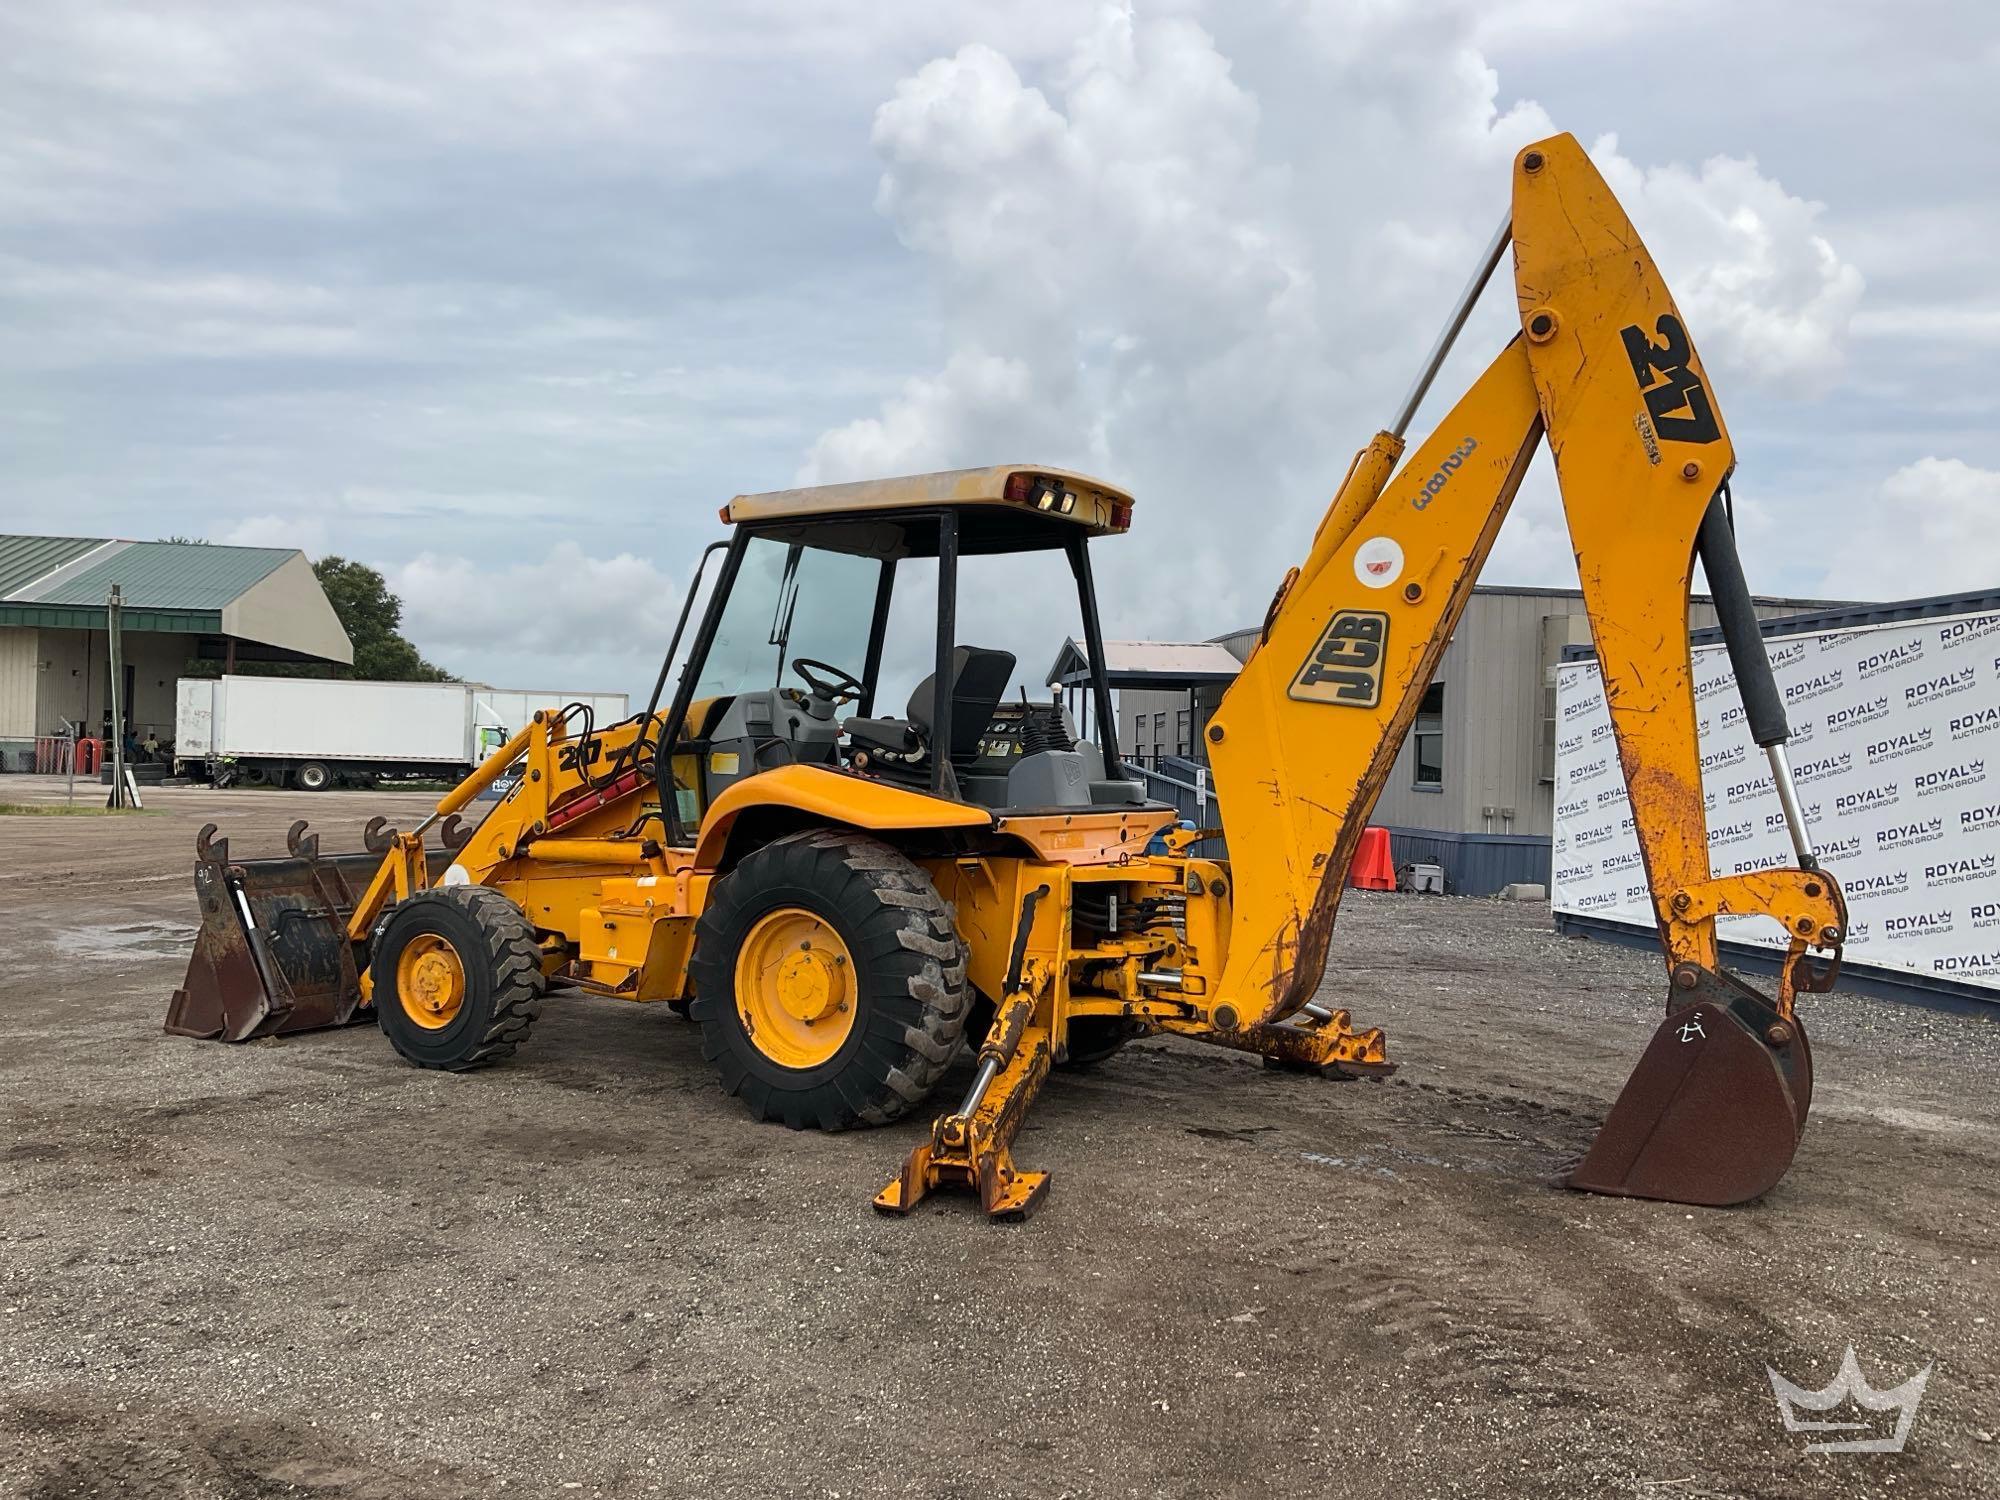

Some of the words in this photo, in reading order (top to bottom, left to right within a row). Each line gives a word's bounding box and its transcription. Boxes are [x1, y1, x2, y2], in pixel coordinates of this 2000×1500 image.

[1620, 314, 1722, 444] 217
[1943, 632, 1981, 650] AUCTION
[1300, 616, 1383, 700] JCB
[1770, 648, 1793, 664] YAL
[1858, 646, 1909, 672] ROYAL
[1860, 665, 1894, 680] AUCTION
[1896, 653, 1924, 667] GROUP
[1786, 676, 1829, 698] ROYAL
[1906, 674, 1959, 699] ROYAL
[1907, 691, 1943, 708] AUCTION
[1945, 681, 1976, 696] GROUP
[1565, 696, 1593, 716] ROYAL
[1721, 707, 1745, 722] ROY
[1827, 702, 1875, 726] ROYAL
[1950, 706, 2000, 731] ROYA
[1952, 725, 1991, 741] AUCTION
[1559, 738, 1575, 749] YAL
[1867, 734, 1918, 757] ROYAL
[1869, 751, 1903, 765] AUCTION
[1905, 742, 1933, 755] GROUP
[1570, 763, 1599, 779] ROYAL
[1794, 757, 1839, 778] ROYAL
[1915, 766, 1969, 788] ROYAL
[1917, 781, 1954, 797] AUCTION
[1955, 775, 1986, 787] GROUP
[1598, 786, 1627, 802] ROYAL
[1727, 778, 1768, 797] ROYAL
[1758, 787, 1776, 797] GROU
[1836, 789, 1884, 809] ROYAL
[1558, 803, 1580, 814] OYAL
[1575, 828, 1604, 842] ROYAL
[1877, 822, 1928, 843] ROYAL
[1879, 840, 1914, 851] AUCTION
[1915, 832, 1943, 844] GROUP
[1813, 841, 1847, 856] OYAL
[1602, 854, 1632, 868] ROYAL
[1735, 857, 1776, 873] ROYAL
[1925, 859, 1980, 878] ROYAL
[1556, 866, 1585, 879] ROYAL
[1928, 876, 1964, 887] AUCTION
[1966, 869, 1996, 881] GROUP
[1627, 885, 1649, 897] ROY
[1845, 875, 1894, 893] ROYAL
[1847, 890, 1880, 901] AUCTION
[1882, 885, 1909, 896] GROUP
[1579, 894, 1608, 906] ROYAL
[1886, 914, 1937, 931] ROYAL
[1974, 919, 2000, 928] AUCTI
[1888, 930, 1923, 939] AUCTION
[1925, 925, 1953, 935] GROUP
[1934, 955, 1990, 971] ROYAL
